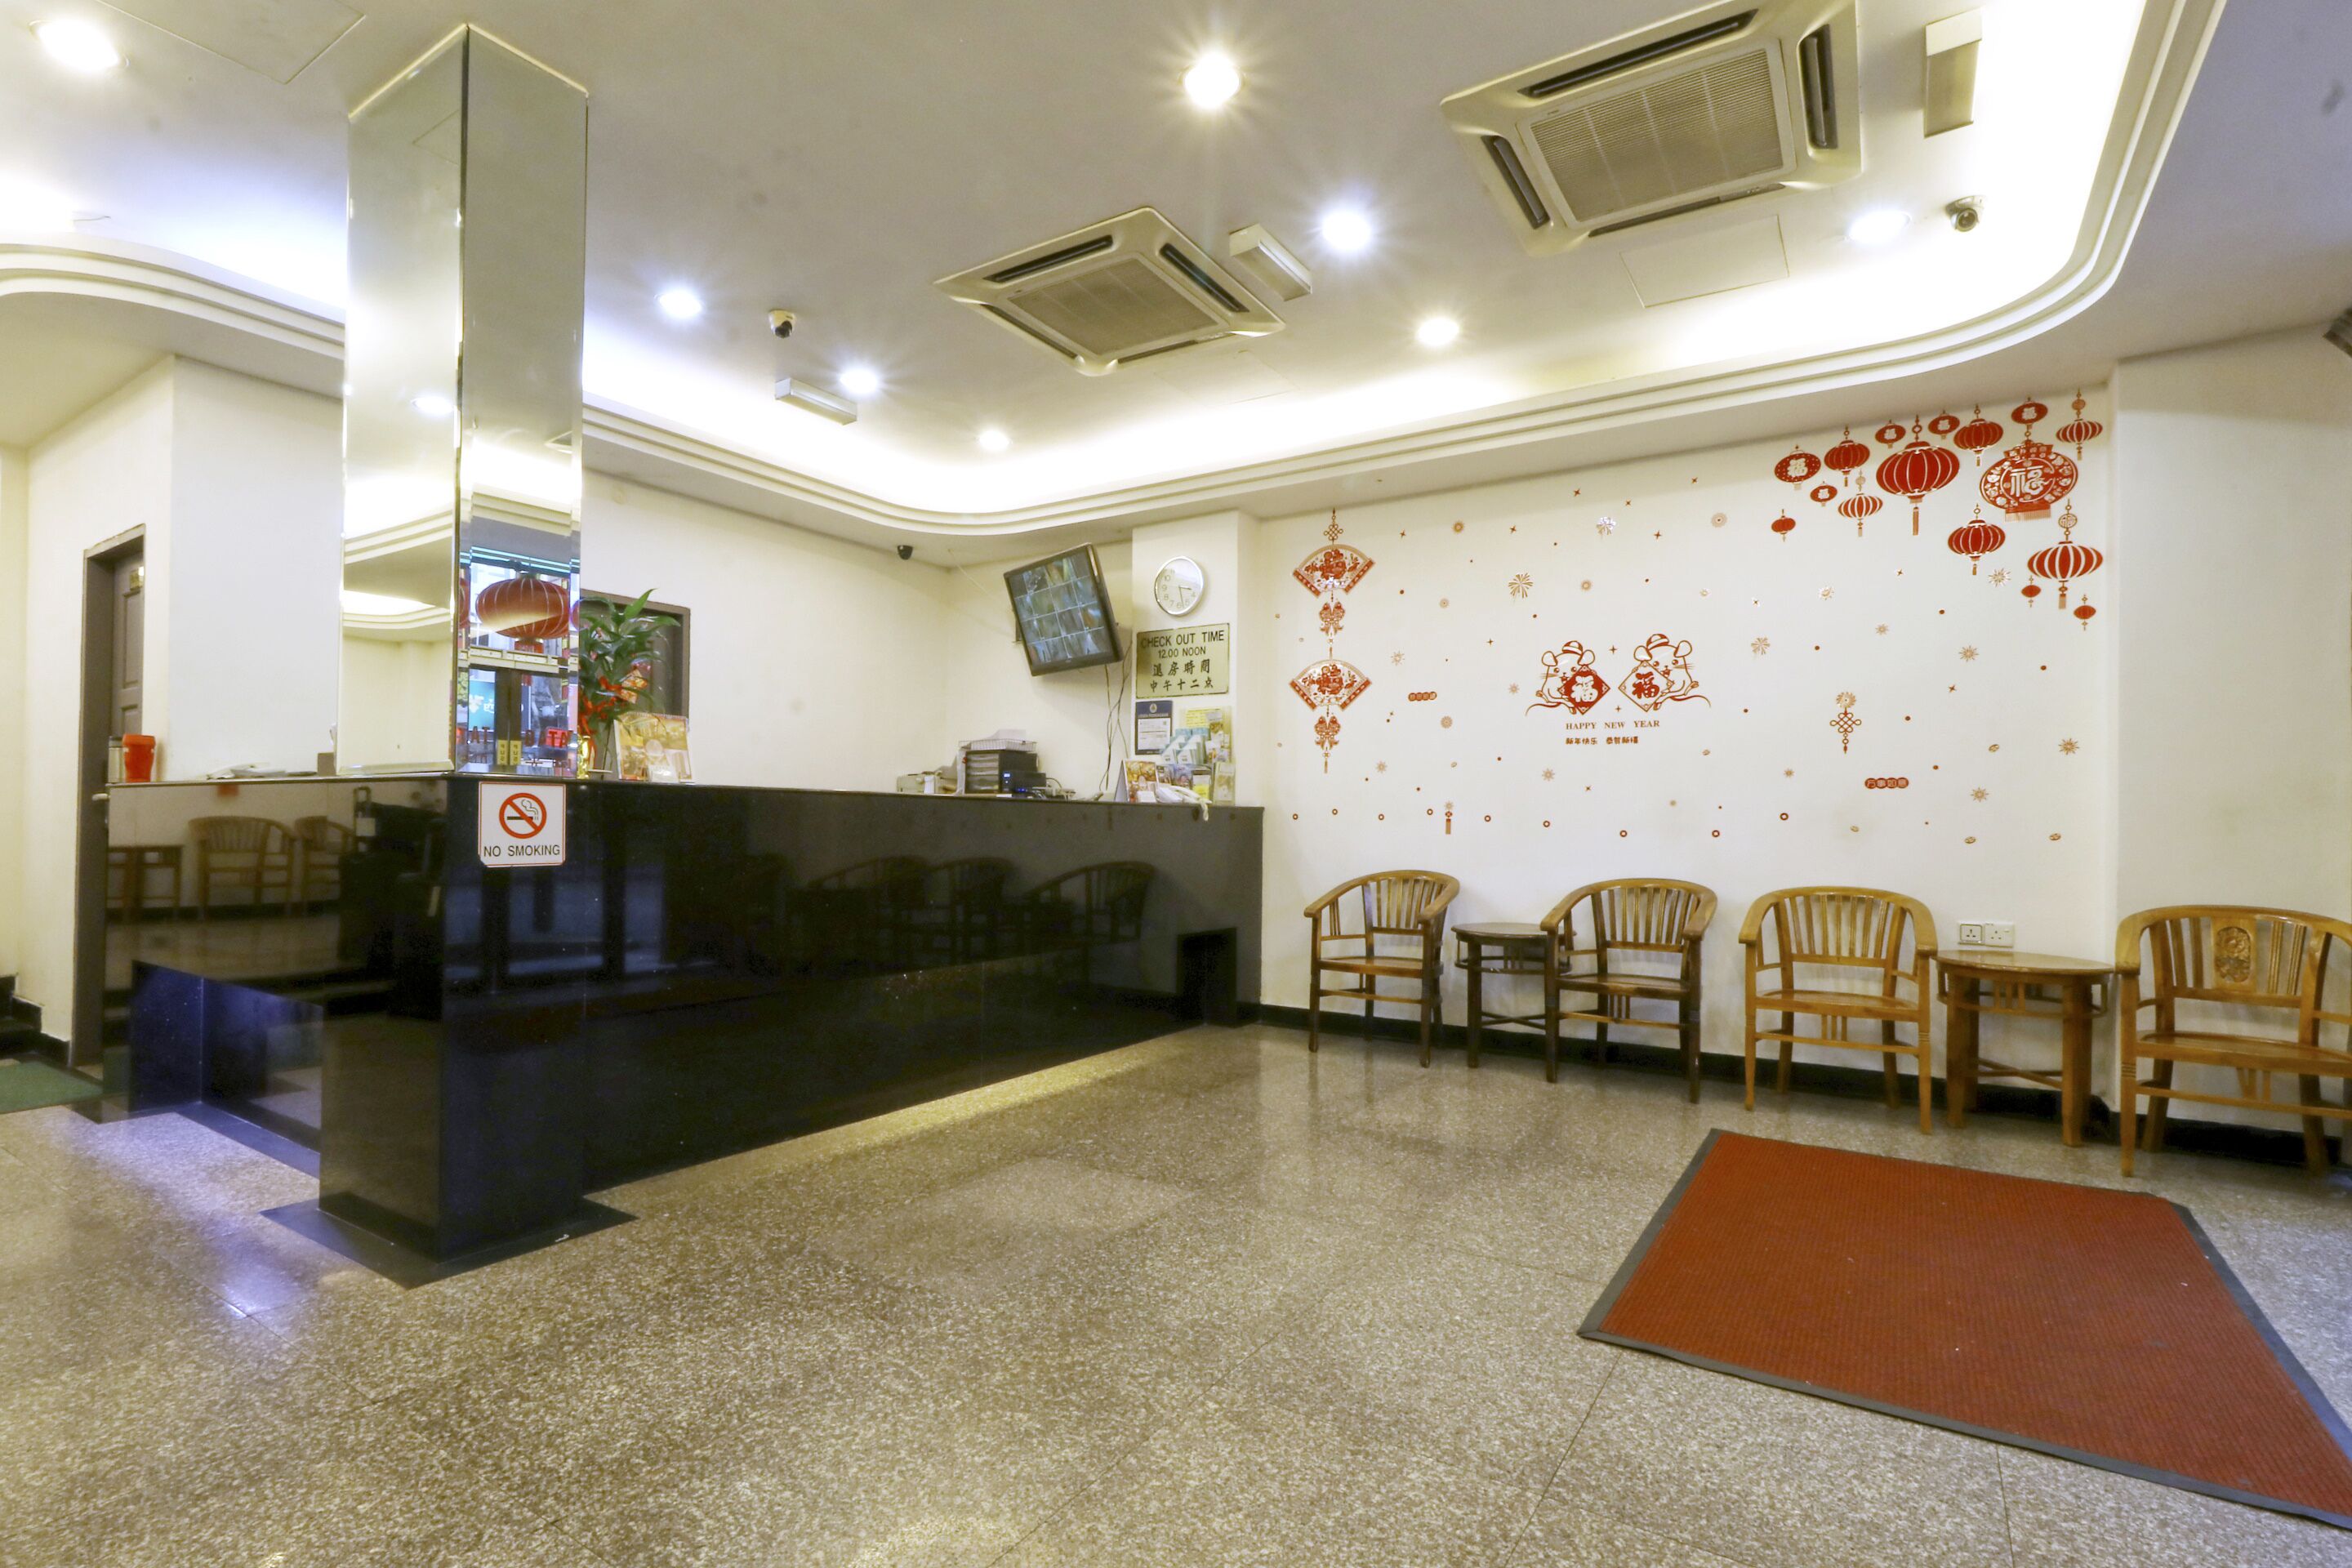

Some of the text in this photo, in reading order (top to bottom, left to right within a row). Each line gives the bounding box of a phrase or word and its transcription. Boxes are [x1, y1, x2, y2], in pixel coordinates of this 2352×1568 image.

[2010, 466, 2047, 497] 福
[1140, 630, 1224, 648] CHECK OUT TIME
[1158, 646, 1206, 659] 12.00 NOON
[1152, 659, 1210, 677] 退房時間
[1150, 676, 1214, 693] 中午十二点
[1632, 670, 1660, 699] 福
[1566, 719, 1660, 730] HAPPY NEW YEAR
[483, 844, 561, 858] NO SMOKING
